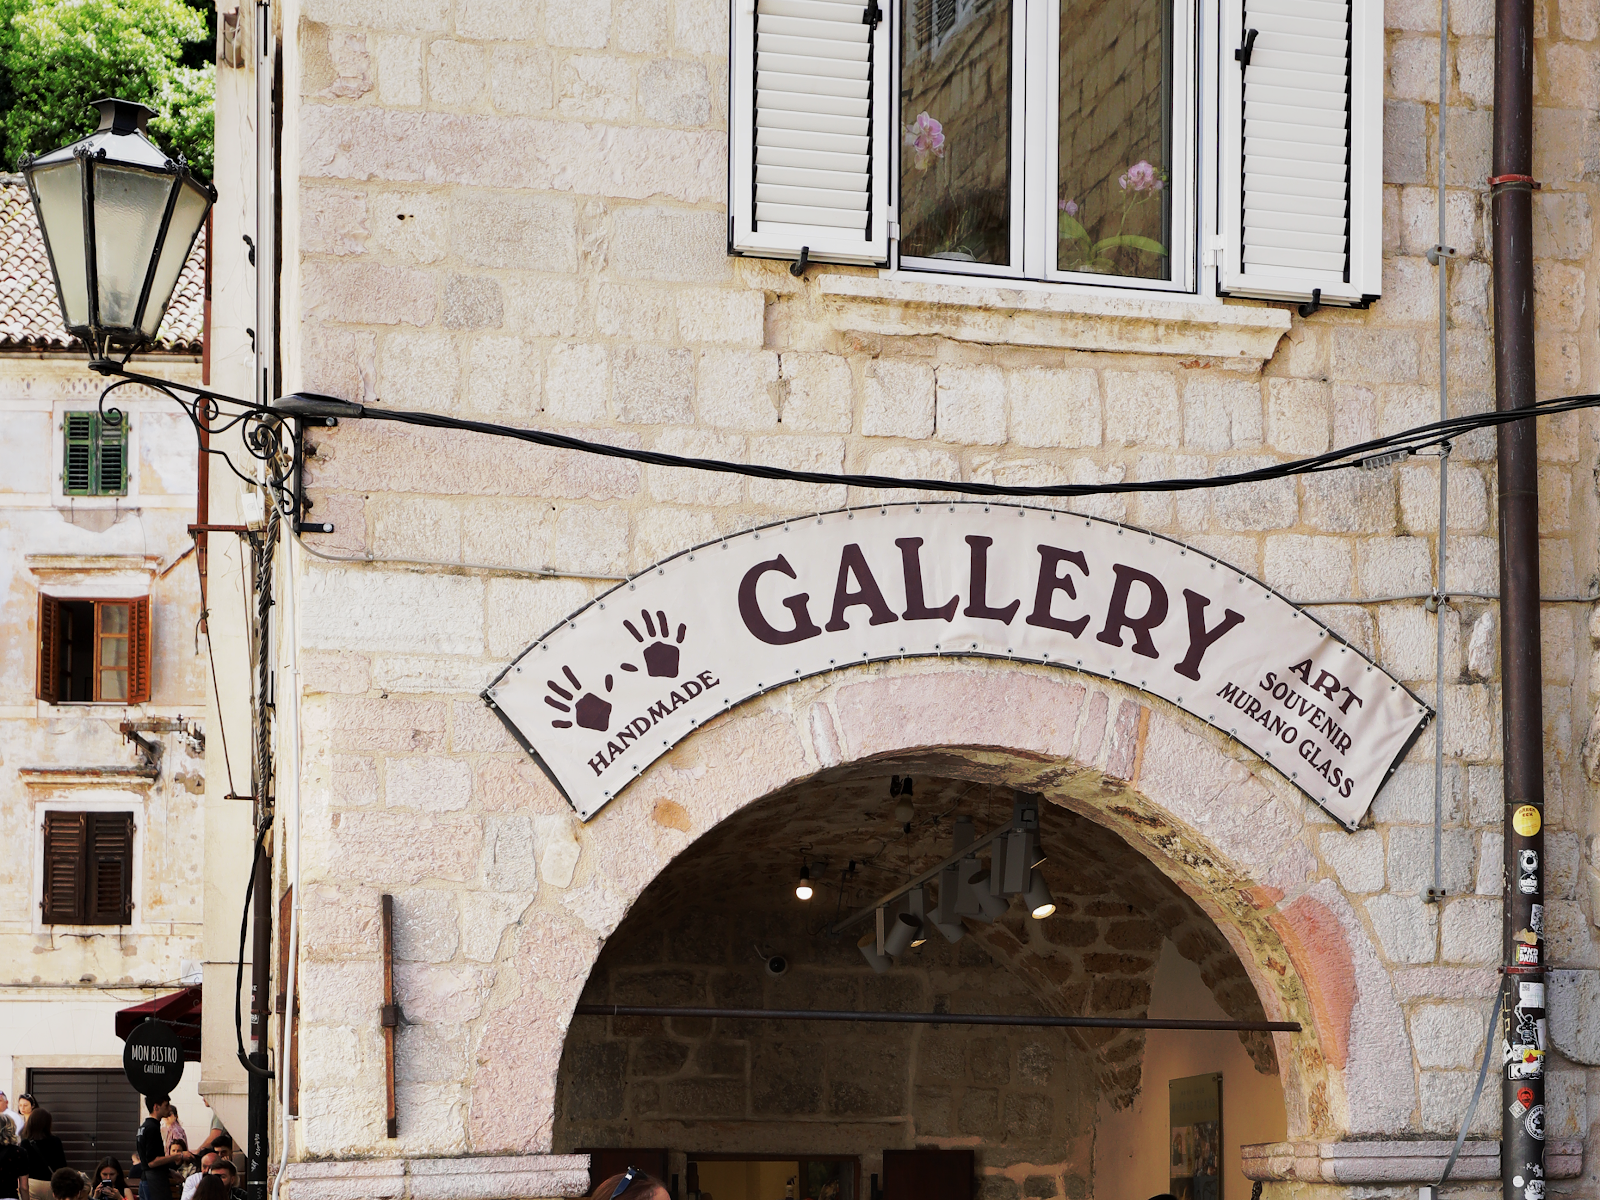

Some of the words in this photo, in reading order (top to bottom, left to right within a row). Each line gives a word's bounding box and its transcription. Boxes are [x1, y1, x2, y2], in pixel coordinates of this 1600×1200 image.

[737, 534, 1245, 682] GALLERY
[587, 670, 720, 777] HANDMADE
[1259, 671, 1353, 757] SOUVENIR
[1288, 658, 1363, 716] ART
[1216, 682, 1298, 744] MURANO
[1298, 740, 1355, 800] GLASS
[131, 1044, 149, 1061] MON
[151, 1046, 178, 1063] BISTRO
